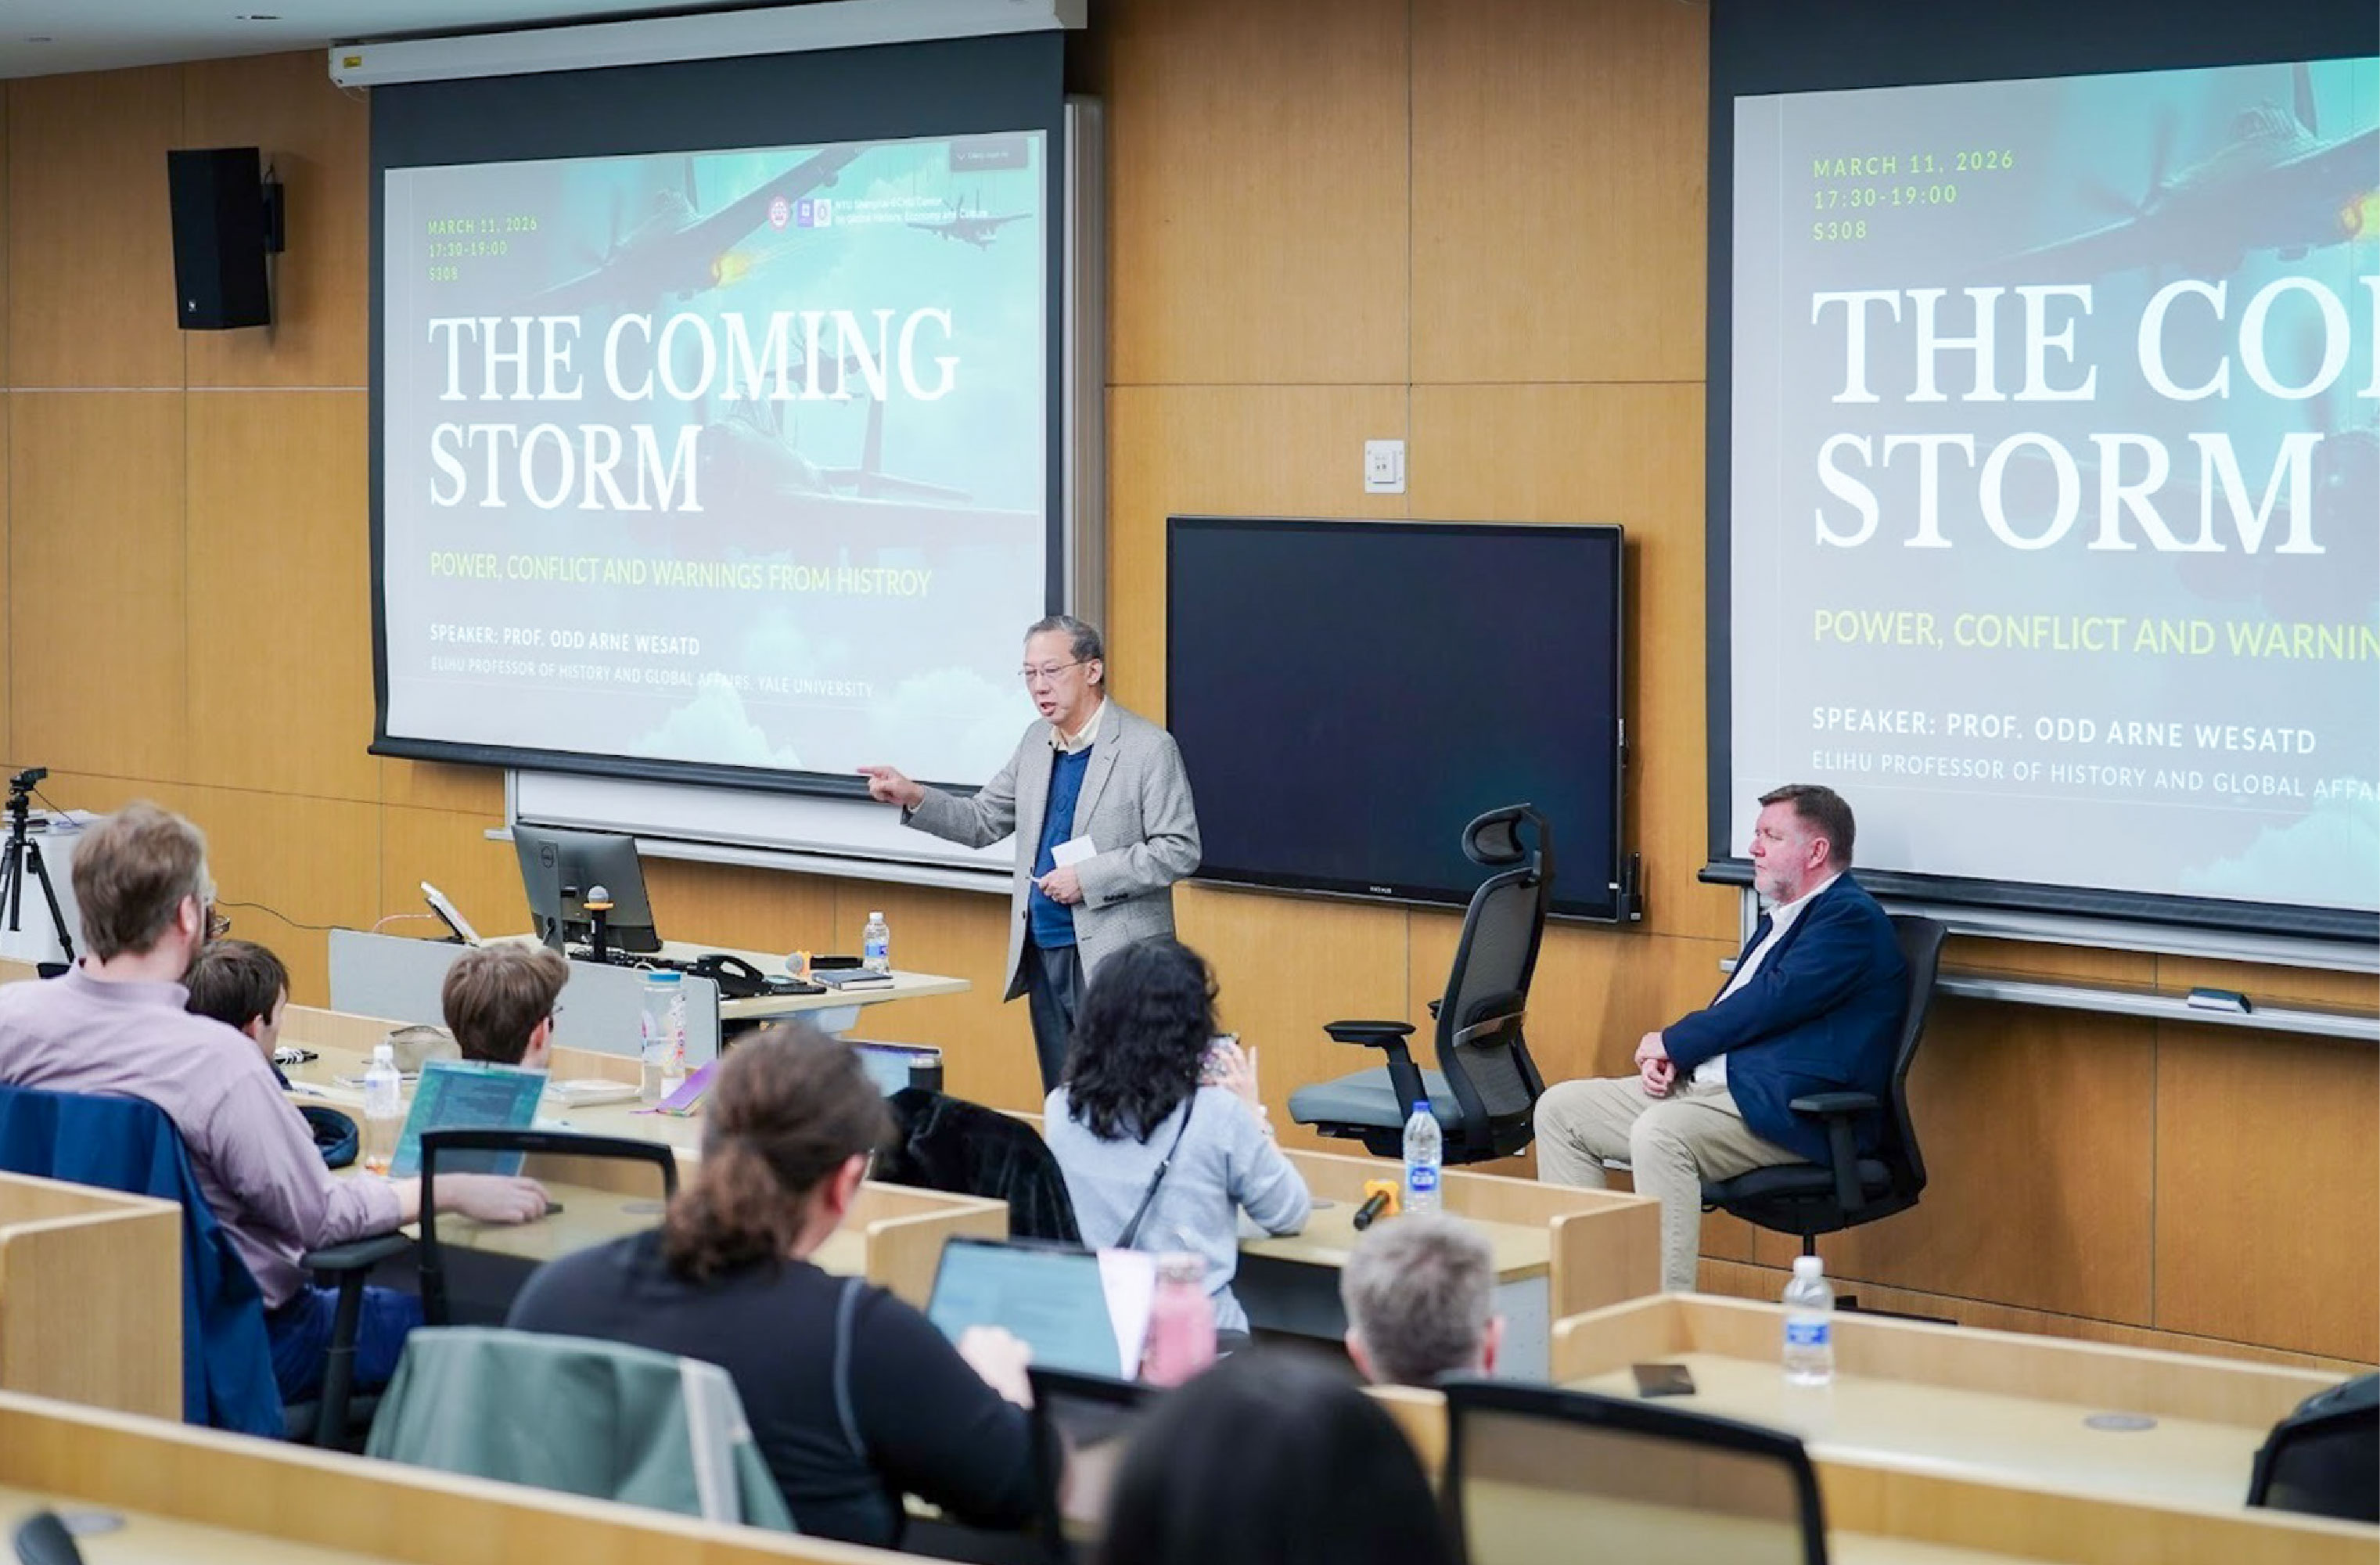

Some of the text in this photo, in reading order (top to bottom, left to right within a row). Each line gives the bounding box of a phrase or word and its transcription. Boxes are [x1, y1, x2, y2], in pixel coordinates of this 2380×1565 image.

[1813, 156, 1897, 177] MARCH
[1956, 150, 2014, 171] 2026
[1814, 184, 1957, 210] 17:30-19:00
[428, 219, 474, 234] MARCH
[506, 216, 537, 232] 2026
[1813, 220, 1867, 240] S308
[430, 239, 508, 257] 17:30-19:00
[428, 308, 961, 401] THE COMING
[1811, 275, 2380, 403] THE CO
[430, 423, 705, 513] STORM
[1814, 432, 2326, 554] STORM
[430, 552, 933, 597] POWER, CONFLICT AND WARNINGS FROM HISTROY
[430, 624, 700, 656] SPEAKER: PROF. ODD ARNE WESATD
[1814, 610, 1943, 651] POWER,
[1954, 613, 2127, 652] CONFLICT
[2134, 618, 2216, 655] AND
[469, 658, 535, 676] PROFESSOR
[539, 663, 555, 677] OF
[560, 664, 610, 682] HISTORY
[614, 667, 641, 684] AND
[645, 669, 692, 686] GLOBAL
[757, 675, 789, 693] YALE
[794, 678, 873, 697] UNIVERSITY
[1812, 707, 2317, 754] SPEAKER: PROF. ODD ARNE WESATD
[1812, 750, 1872, 772] ELIHU
[1882, 754, 2004, 779] PROFESSOR
[2013, 761, 2041, 782] OF
[2050, 763, 2146, 787] HISTORY
[2155, 769, 2204, 791] AND
[2213, 773, 2305, 797] GLOBAL
